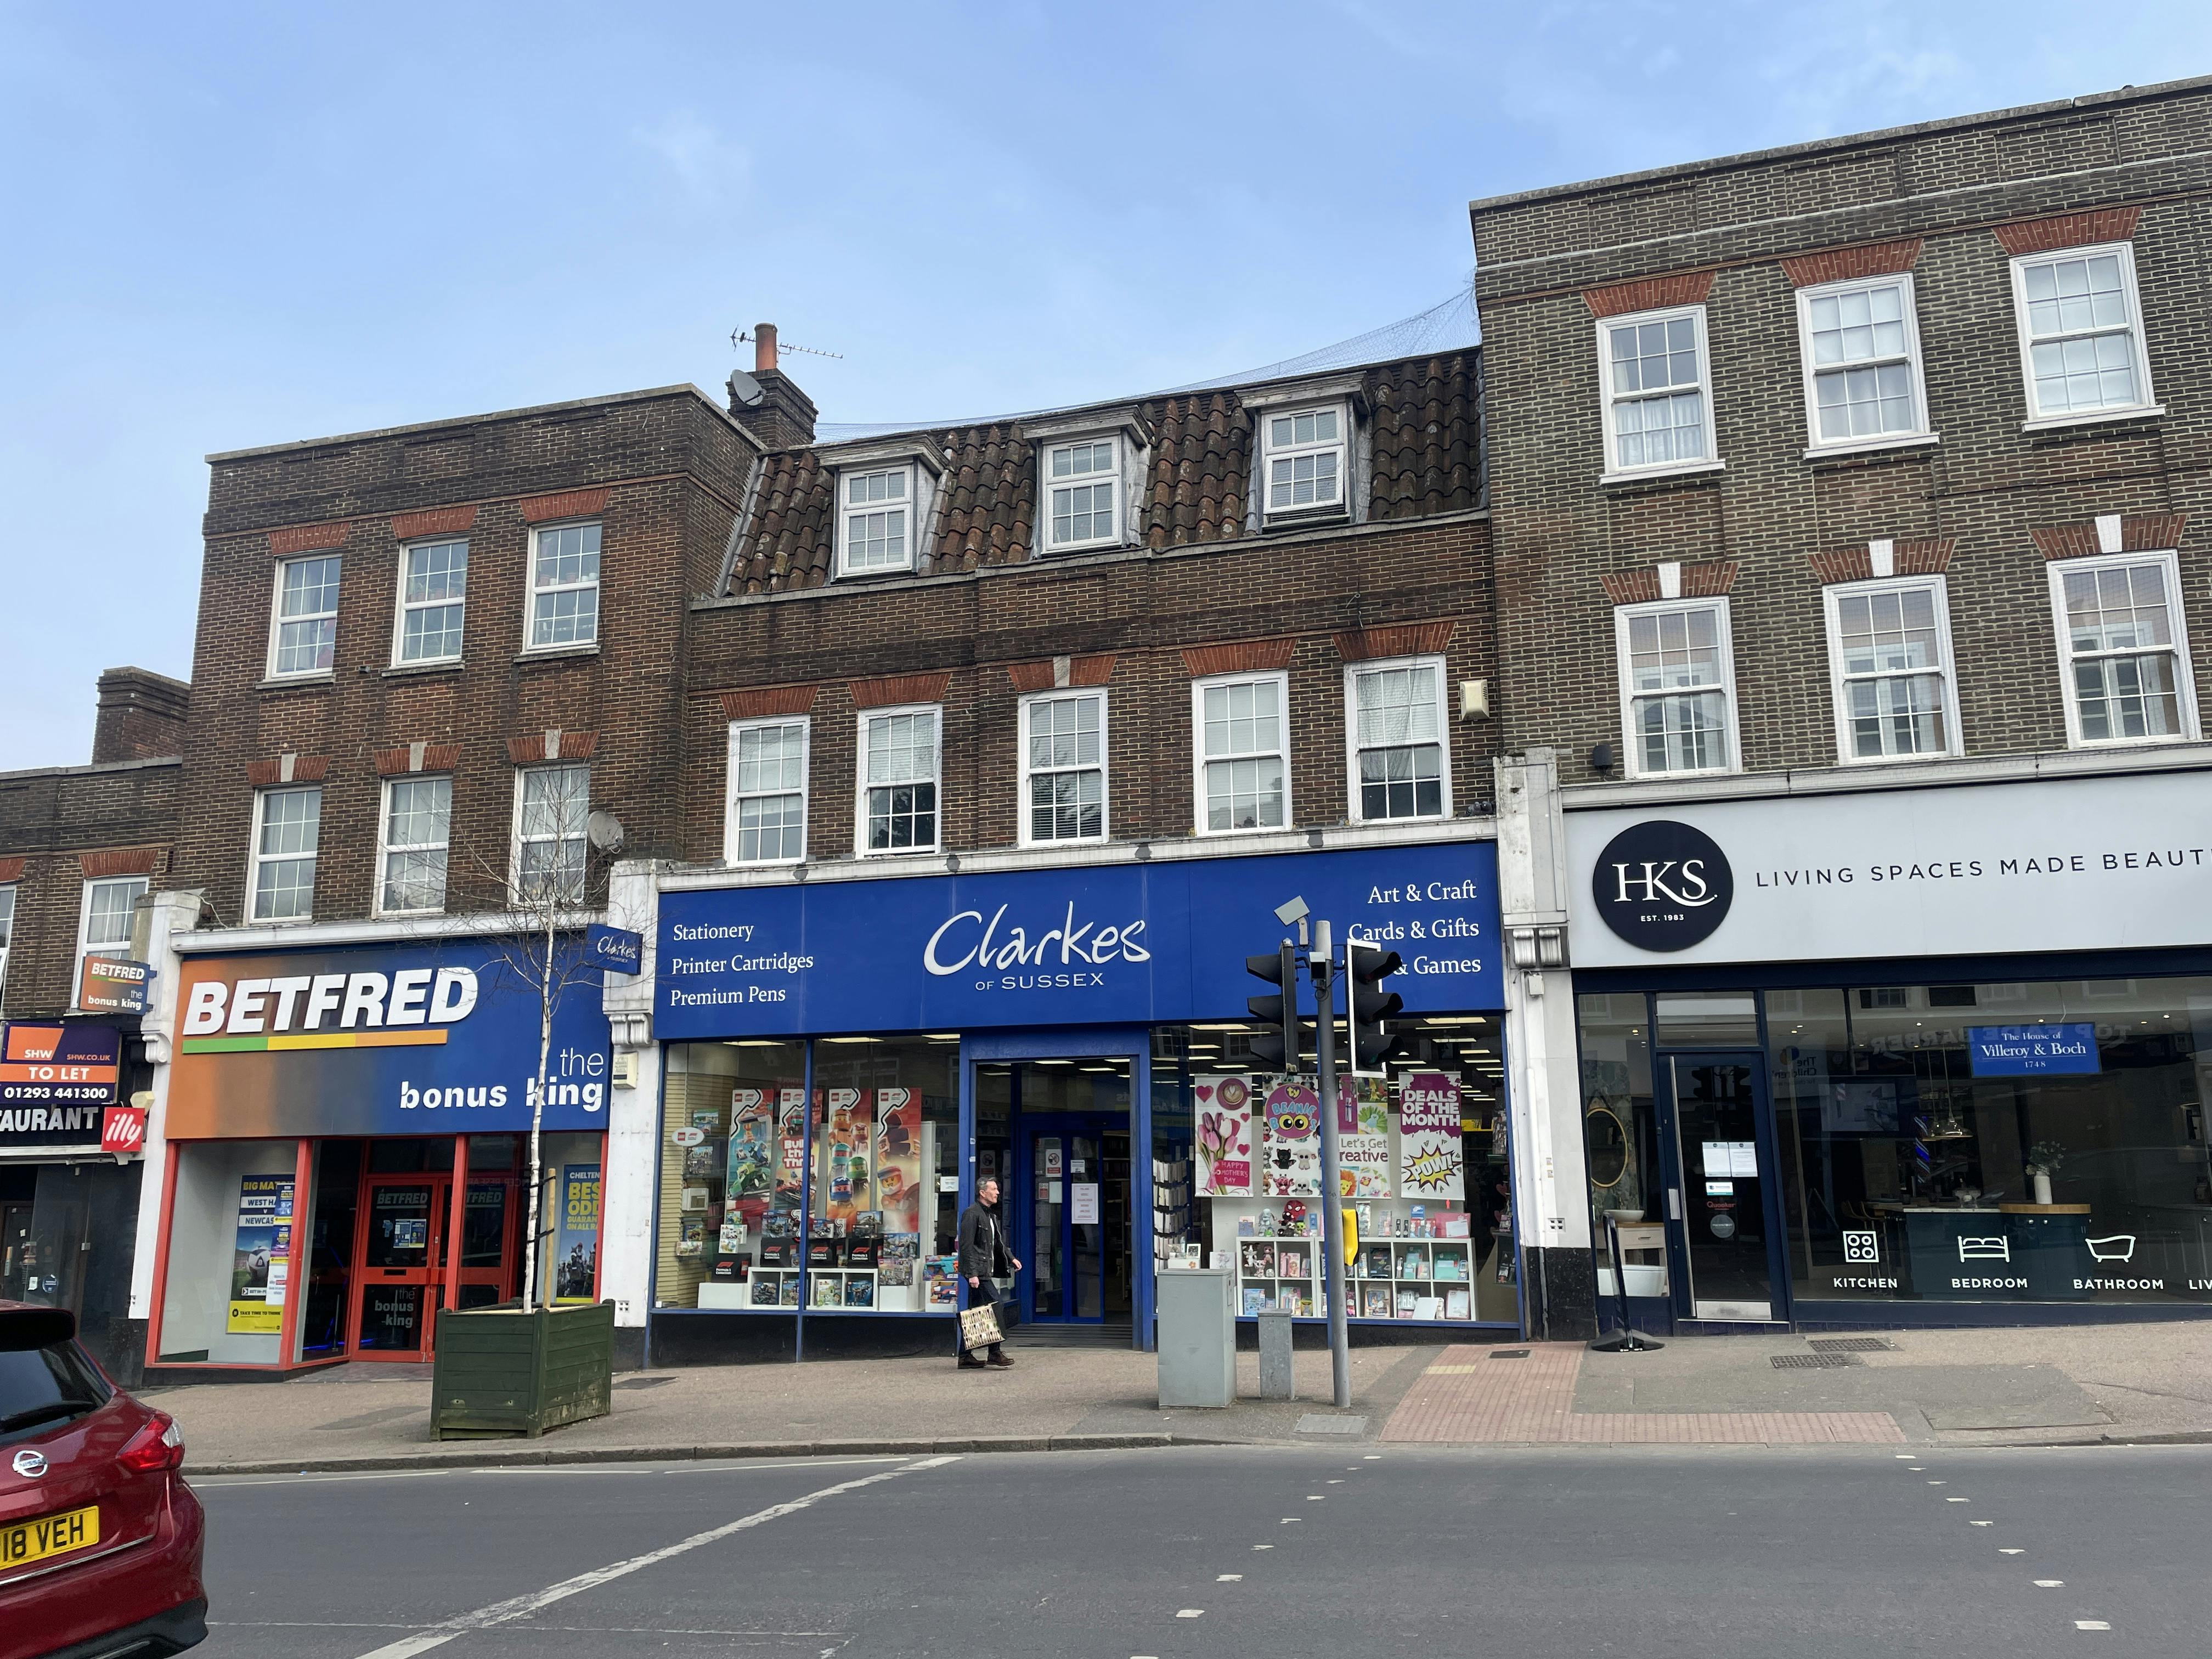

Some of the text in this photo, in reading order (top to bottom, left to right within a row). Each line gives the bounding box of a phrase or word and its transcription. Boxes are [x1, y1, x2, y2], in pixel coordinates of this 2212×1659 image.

[1756, 849, 2212, 887] LIVING SPACES MADE BEAUT
[1368, 879, 1477, 904] Art & Craft
[673, 923, 754, 942] Stationery
[1348, 917, 1479, 941] Cards & Gifts
[923, 900, 1151, 976] Clarkes
[597, 936, 636, 959] Clarkes
[91, 962, 145, 980] BETFRED
[672, 952, 814, 975] Printer Cartridges
[1414, 956, 1481, 975] Games
[975, 973, 1104, 991] OF SUSSEX
[131, 989, 143, 999] the
[182, 967, 478, 1036] BETFRED
[670, 986, 786, 1006] Premium Pens
[88, 995, 142, 1011] bonus king
[2023, 1032, 2049, 1040] House
[24, 1049, 53, 1058] SHW
[1981, 1042, 2086, 1058] Villeroy & Boch
[560, 1047, 603, 1076] the
[29, 1066, 90, 1080] TO LET
[4, 1087, 108, 1099] 01293 441300
[399, 1076, 603, 1112] bonus king
[1404, 1090, 1457, 1102] DEALS
[1272, 1101, 1317, 1116] BEANIE
[1402, 1102, 1459, 1114] OF THE
[0, 1107, 99, 1132] AURANT
[1402, 1114, 1461, 1126] MONTH
[105, 1113, 141, 1149] illy
[784, 1139, 804, 1149] Buil
[1341, 1138, 1387, 1148] Let's Get
[1339, 1148, 1388, 1162] reative
[1221, 1170, 1248, 1178] MOTHER'S
[1410, 1153, 1453, 1181] POW!
[243, 1182, 258, 1190] BIG
[568, 1182, 600, 1200] BES
[377, 1192, 428, 1204] BETFRED
[467, 1192, 502, 1203] TFRED
[1833, 1278, 1898, 1289] KITCHEN
[1951, 1278, 2028, 1288] BEDROOM
[2073, 1279, 2164, 1289] BATHROOM
[2188, 1279, 2212, 1289] LIV
[399, 1288, 415, 1300] the
[375, 1300, 414, 1312] bonus
[386, 1313, 413, 1328] king
[3, 1514, 84, 1562] 18 VEH
